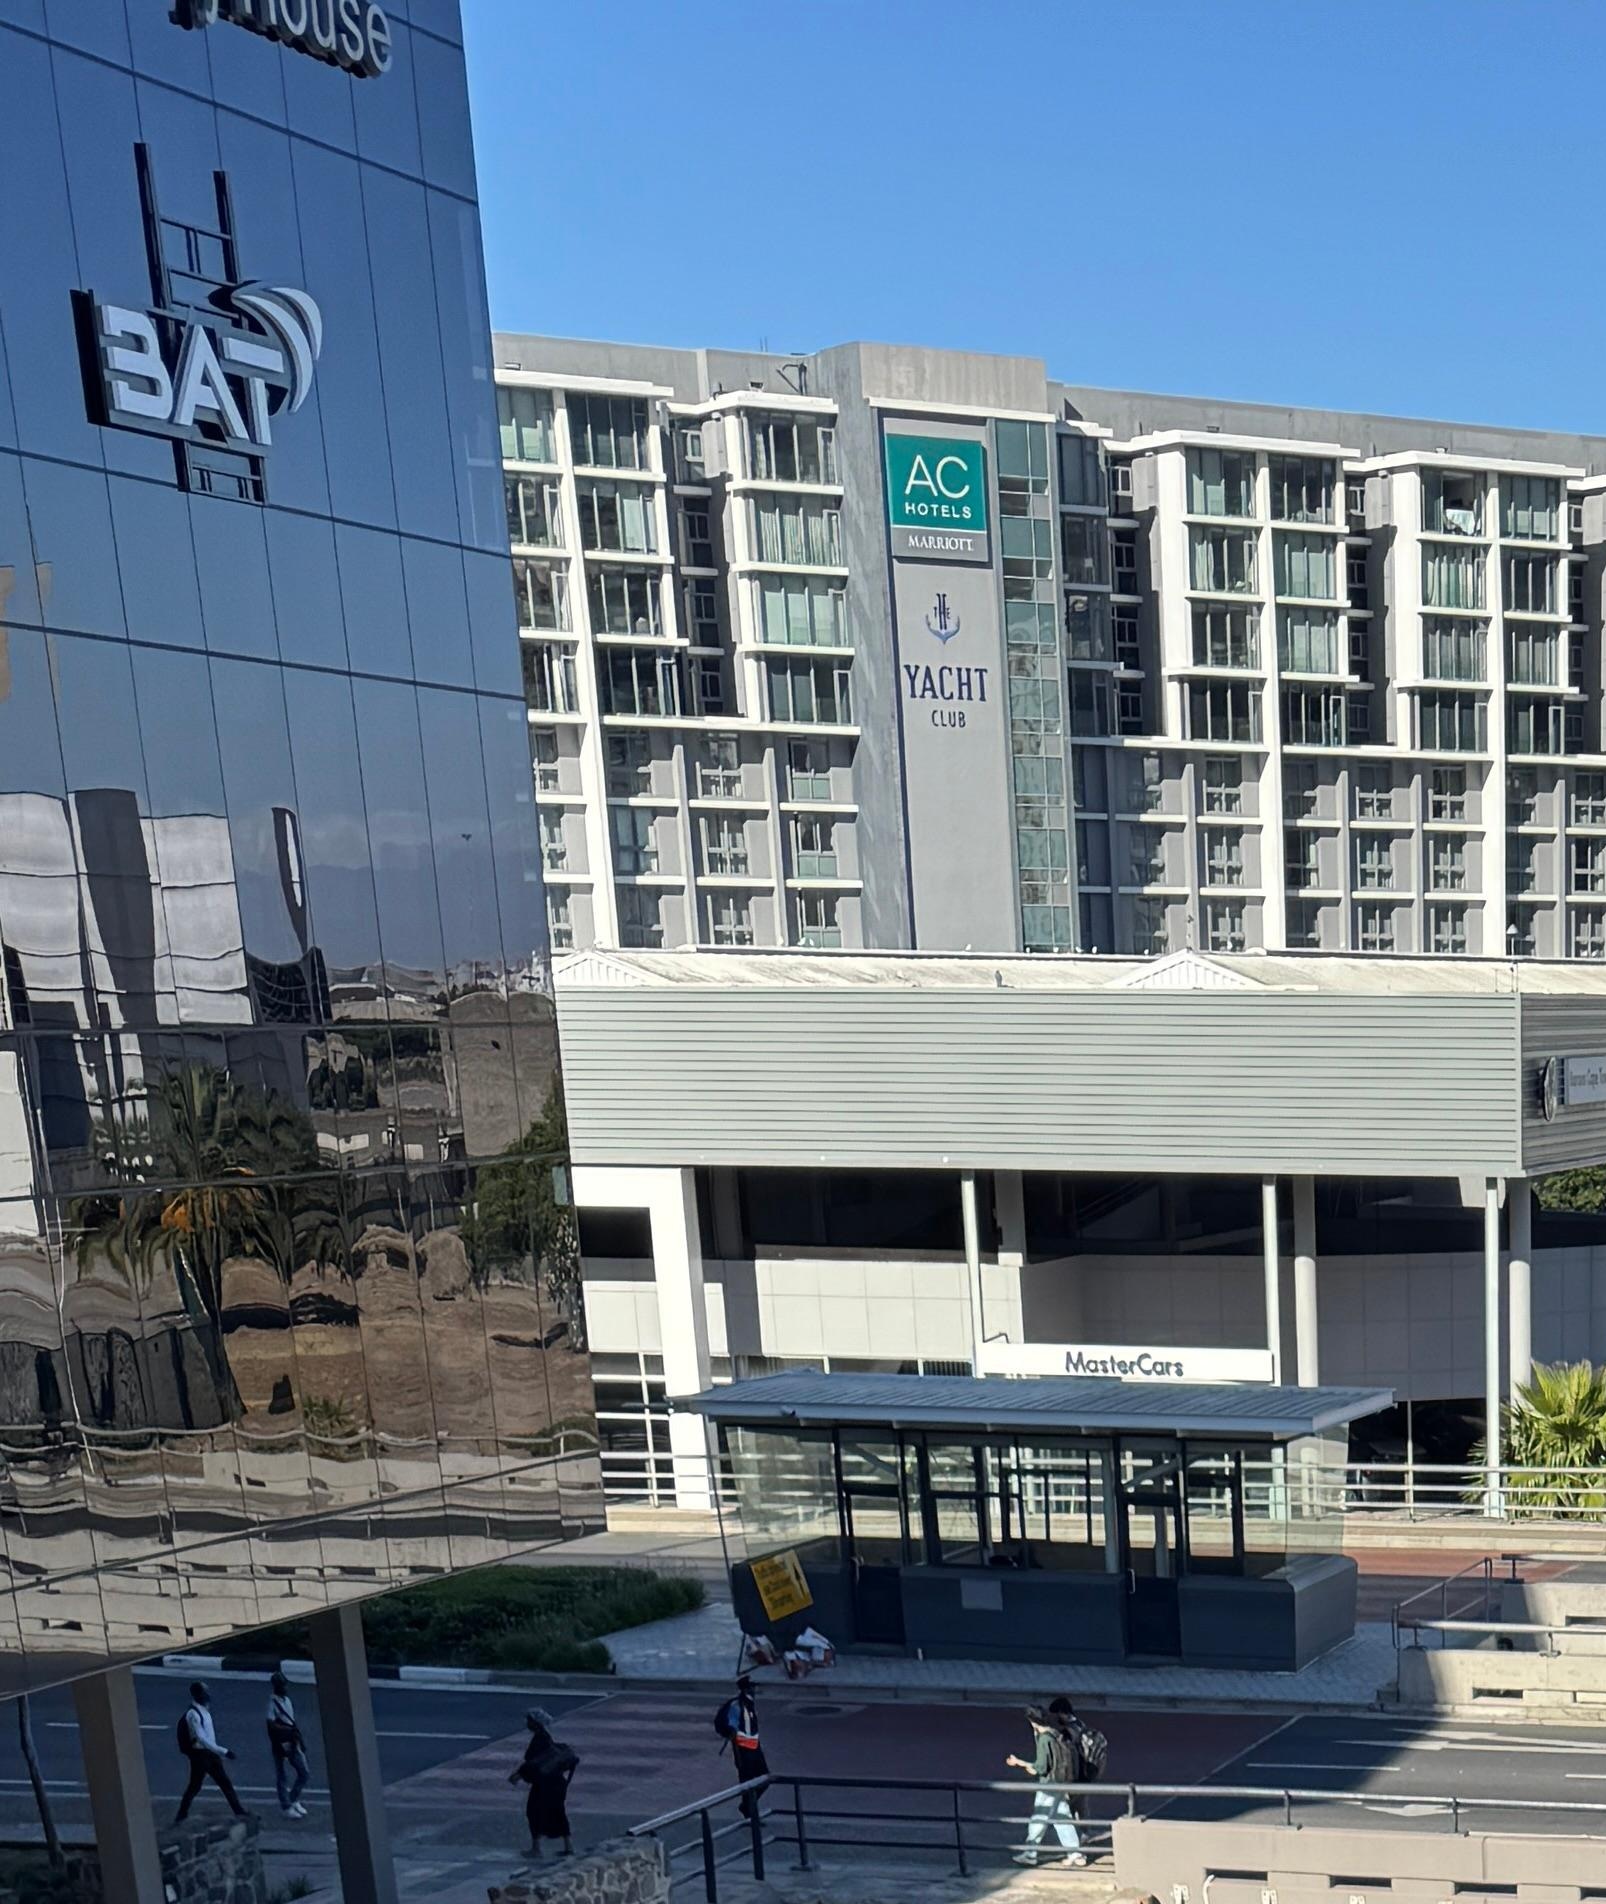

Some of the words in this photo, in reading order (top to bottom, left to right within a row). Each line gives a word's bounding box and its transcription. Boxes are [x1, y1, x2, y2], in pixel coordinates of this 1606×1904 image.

[243, 0, 392, 73] ouse
[101, 304, 285, 446] BAT
[904, 454, 971, 500] AC
[904, 501, 973, 519] HOTELS
[908, 535, 974, 552] MARRIOTT
[903, 664, 988, 702] YACHT
[931, 709, 967, 728] CLUB
[1065, 1351, 1185, 1378] MasterCars
